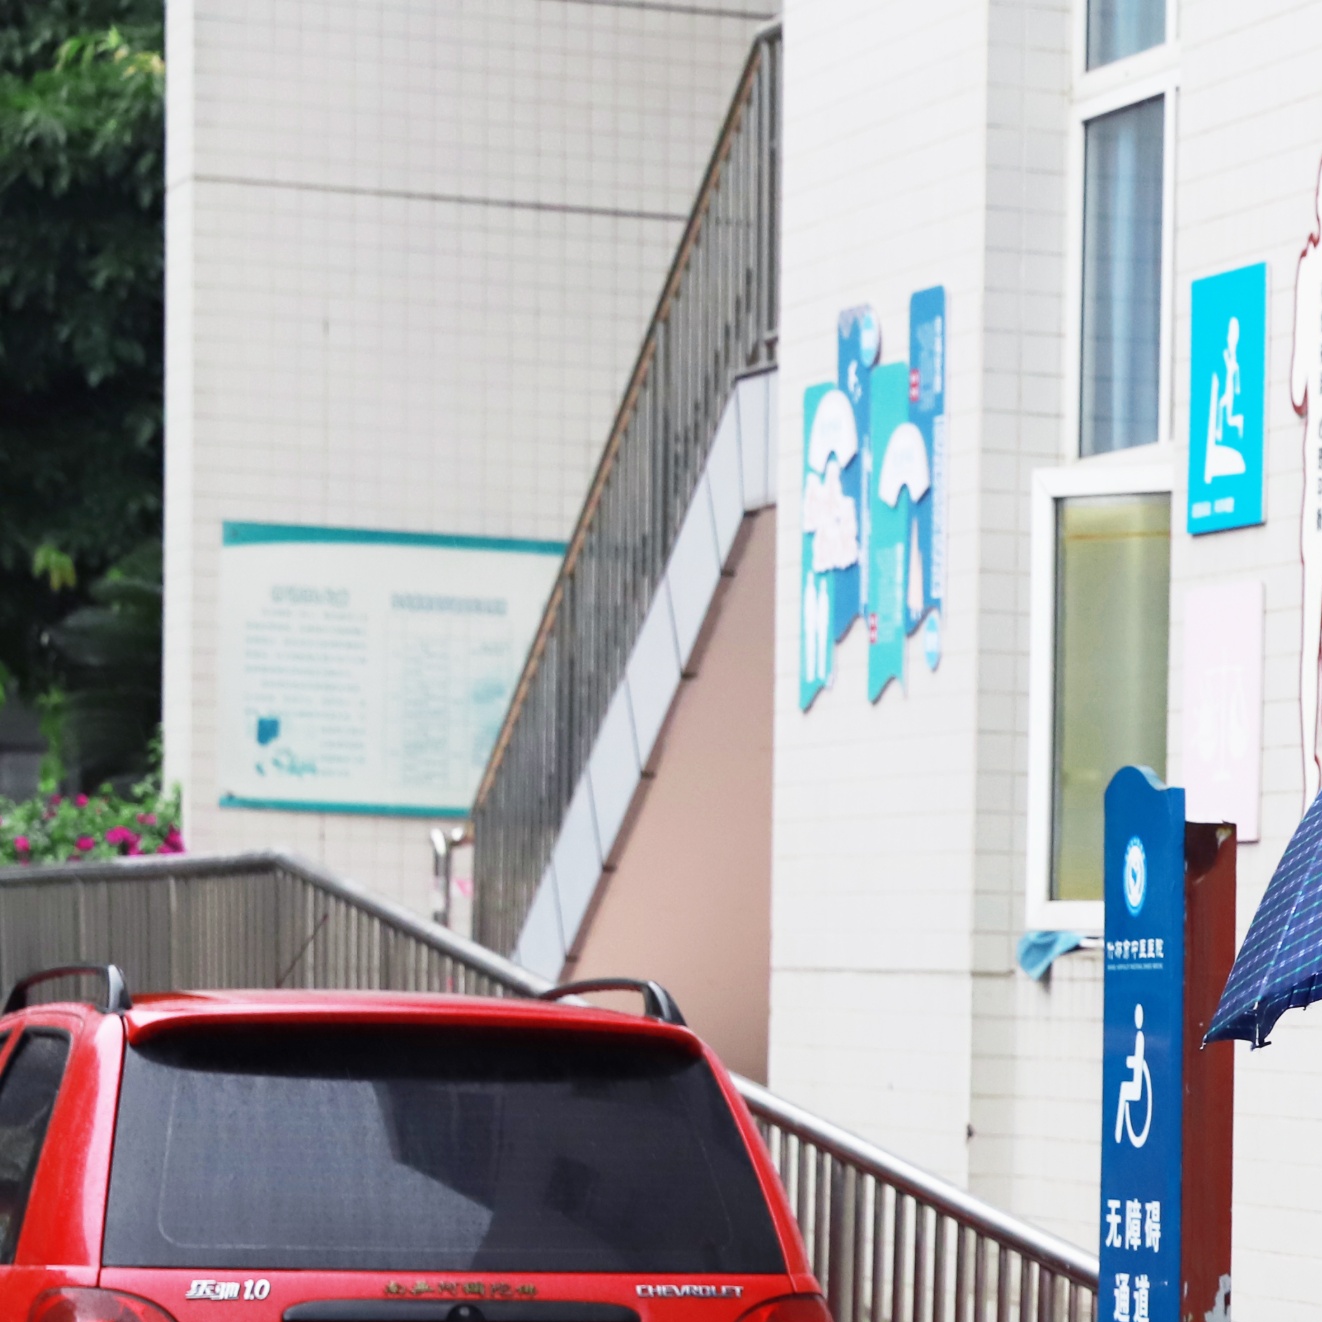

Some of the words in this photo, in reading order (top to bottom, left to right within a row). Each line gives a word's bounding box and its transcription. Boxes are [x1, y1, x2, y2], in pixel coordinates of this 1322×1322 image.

[1105, 1198, 1161, 1253] 无障碍
[635, 1284, 744, 1298] CHEVROLET
